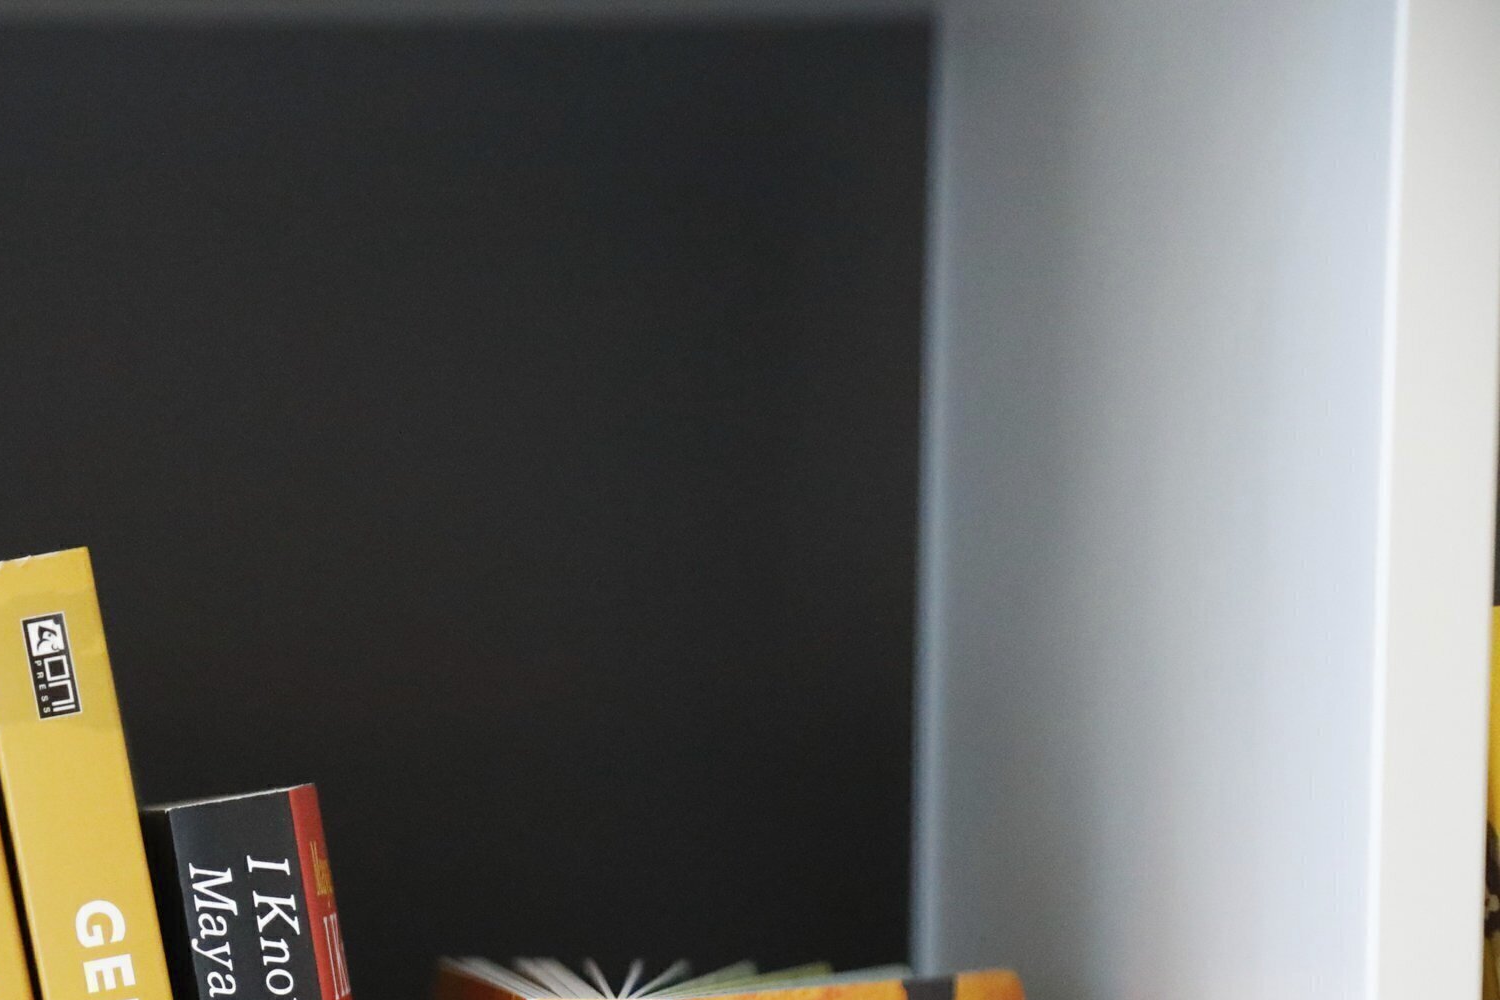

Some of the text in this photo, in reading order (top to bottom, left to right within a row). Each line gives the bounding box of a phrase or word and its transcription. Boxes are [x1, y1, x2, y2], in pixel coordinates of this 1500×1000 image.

[34, 659, 51, 714] PRESS
[247, 854, 291, 877] I
[188, 862, 239, 998] Maya
